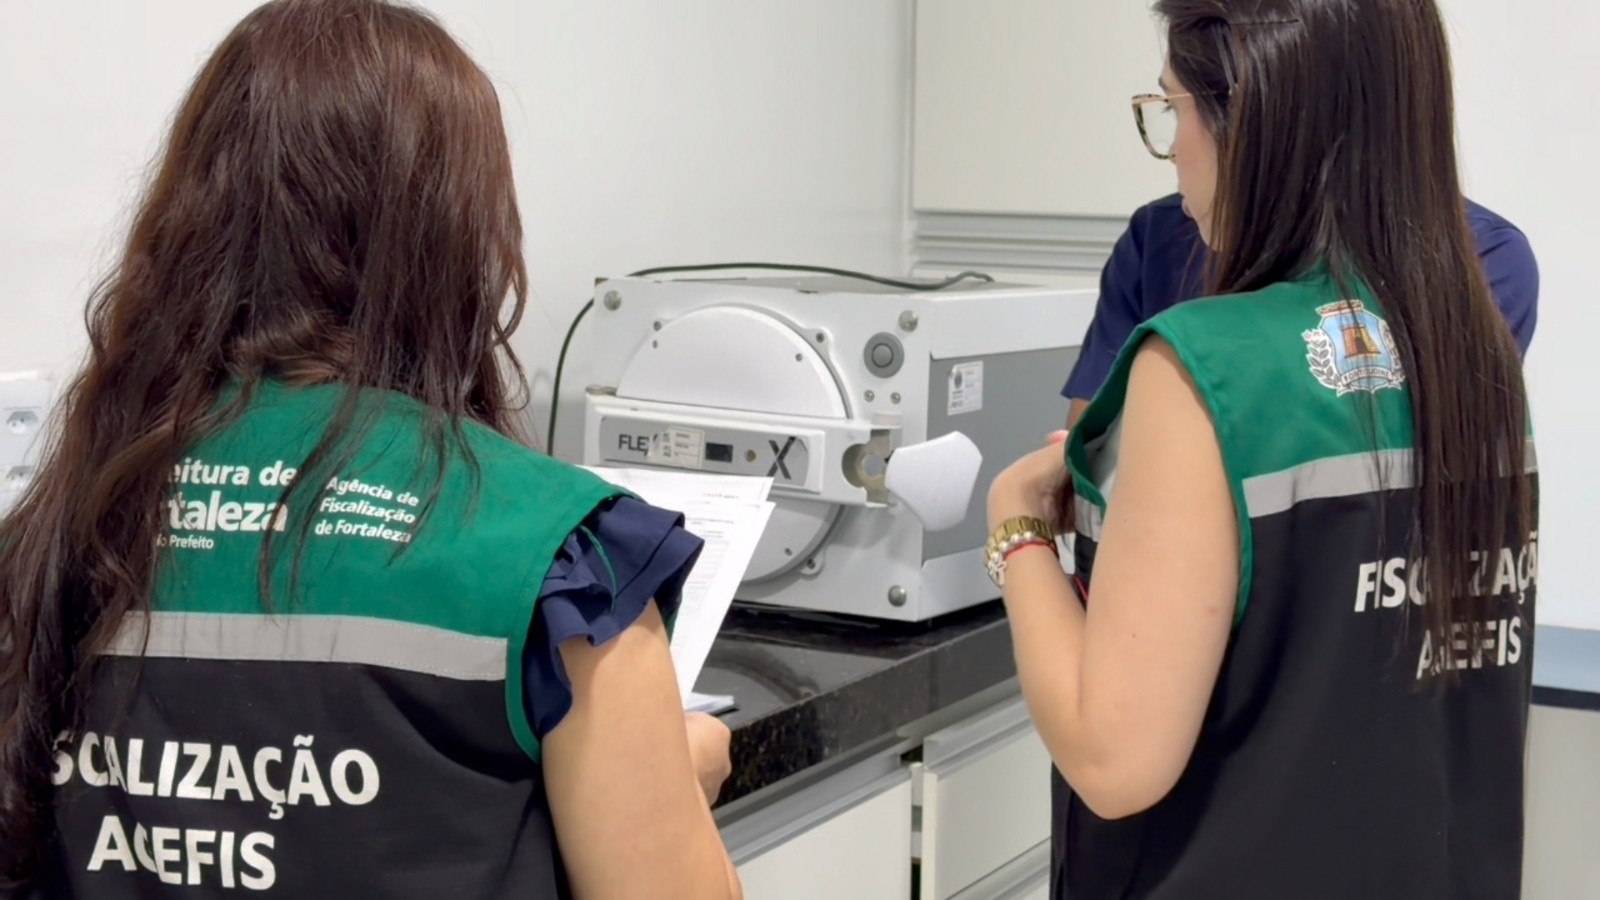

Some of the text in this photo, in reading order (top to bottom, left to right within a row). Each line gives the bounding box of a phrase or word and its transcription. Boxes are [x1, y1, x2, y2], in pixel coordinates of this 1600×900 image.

[259, 460, 297, 486] de
[326, 476, 419, 507] Agência de
[168, 491, 288, 532] taleza
[319, 497, 416, 524] Fiscalização
[169, 534, 214, 549] Prefeito
[315, 519, 412, 544] de Fortaleza
[1416, 615, 1522, 680] AEFIS
[51, 731, 380, 820] SCALIZAÇÃO
